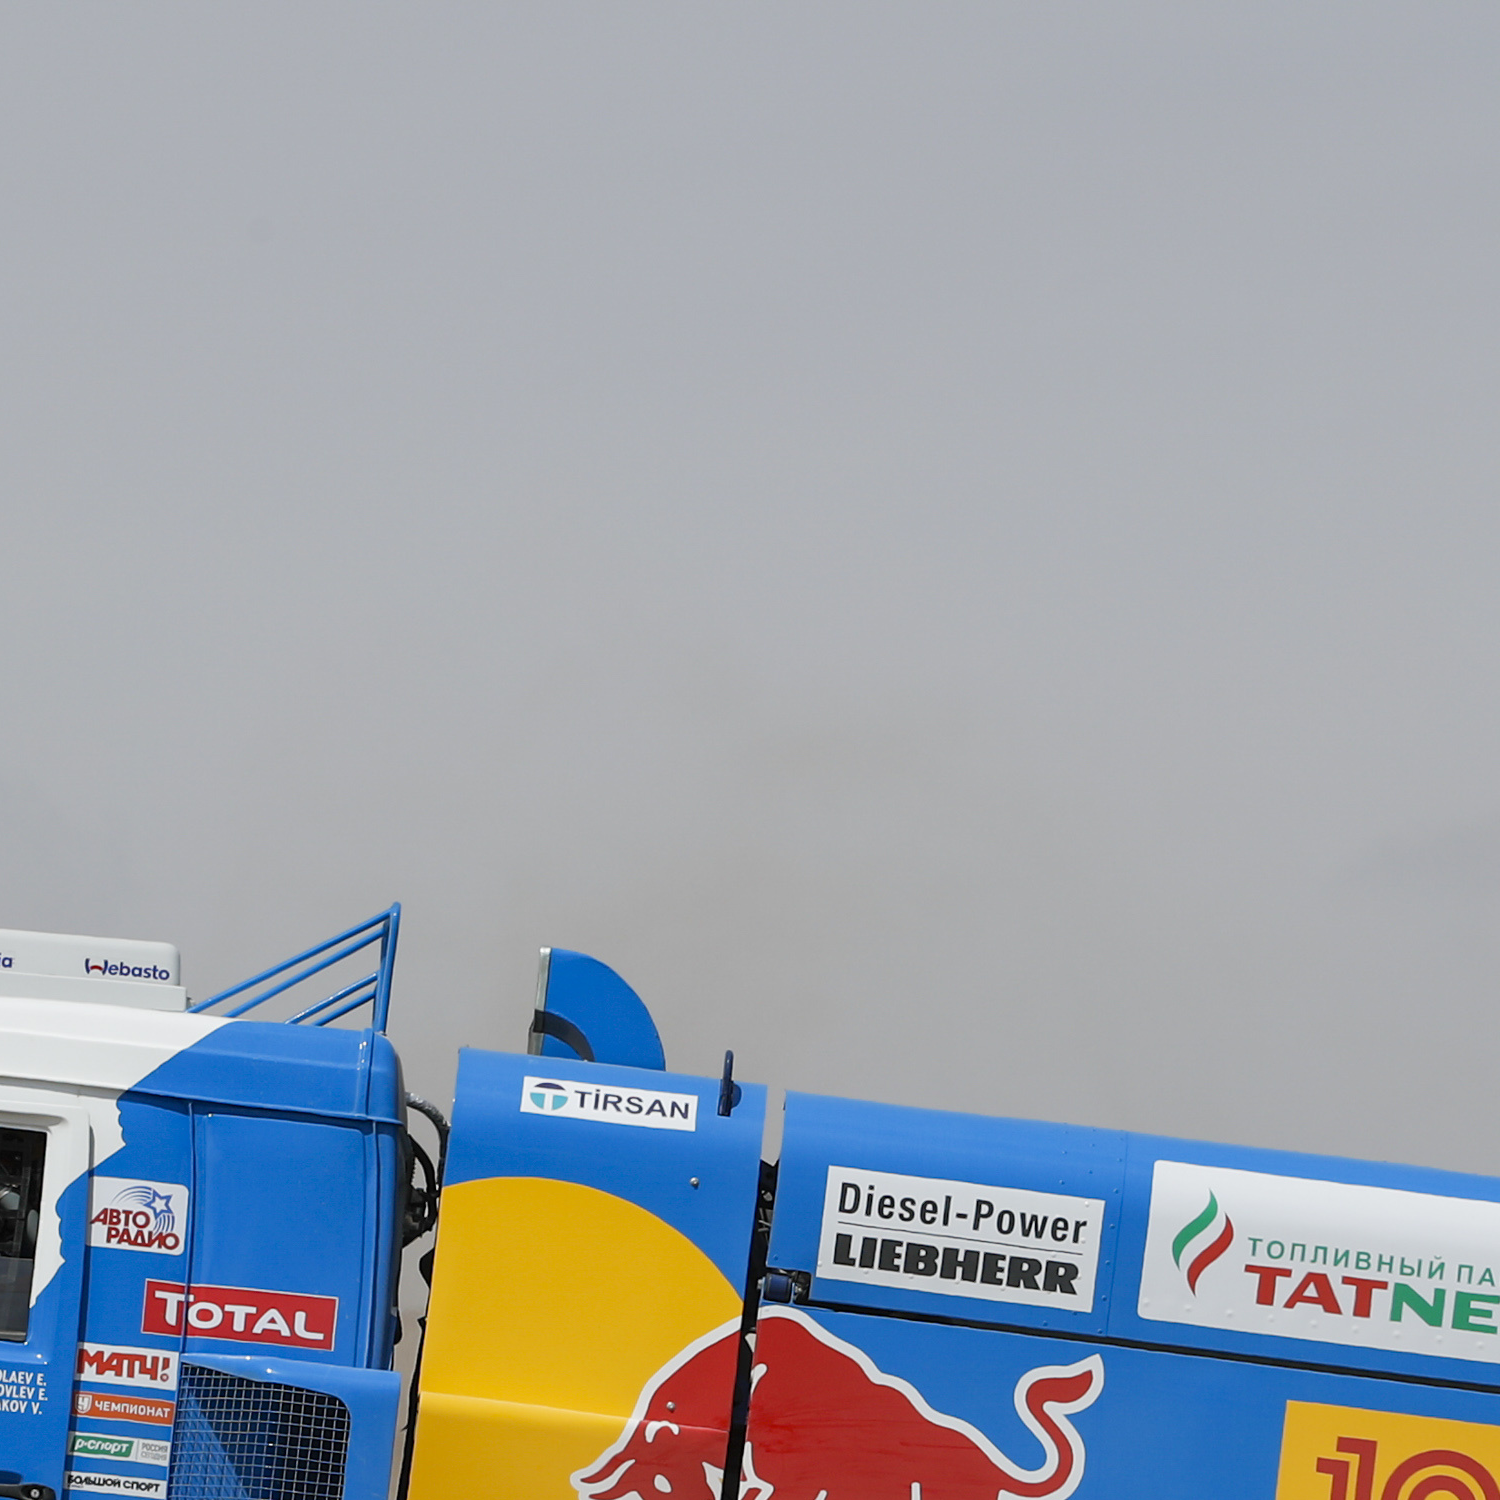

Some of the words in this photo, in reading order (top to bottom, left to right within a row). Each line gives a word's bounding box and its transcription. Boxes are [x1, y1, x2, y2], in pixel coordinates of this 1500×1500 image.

[85, 957, 171, 981] Webasto
[90, 1208, 151, 1229] АВТО
[838, 1182, 1088, 1244] Diesel-Power
[106, 1227, 180, 1250] РАДИО
[833, 1232, 1079, 1295] LIEBHERR
[1248, 1237, 1446, 1280] ТОПЛИВНЫЙ
[154, 1289, 325, 1340] TOTAL
[77, 1348, 171, 1382] МАТЧ!
[36, 1373, 47, 1386] E.
[38, 1388, 48, 1401] E.
[31, 1401, 43, 1415] V.
[95, 1400, 171, 1418] ЧЕМПИОНАТ
[68, 1475, 120, 1488] БОЛЬШОЙ
[122, 1480, 160, 1493] СПОРТ
